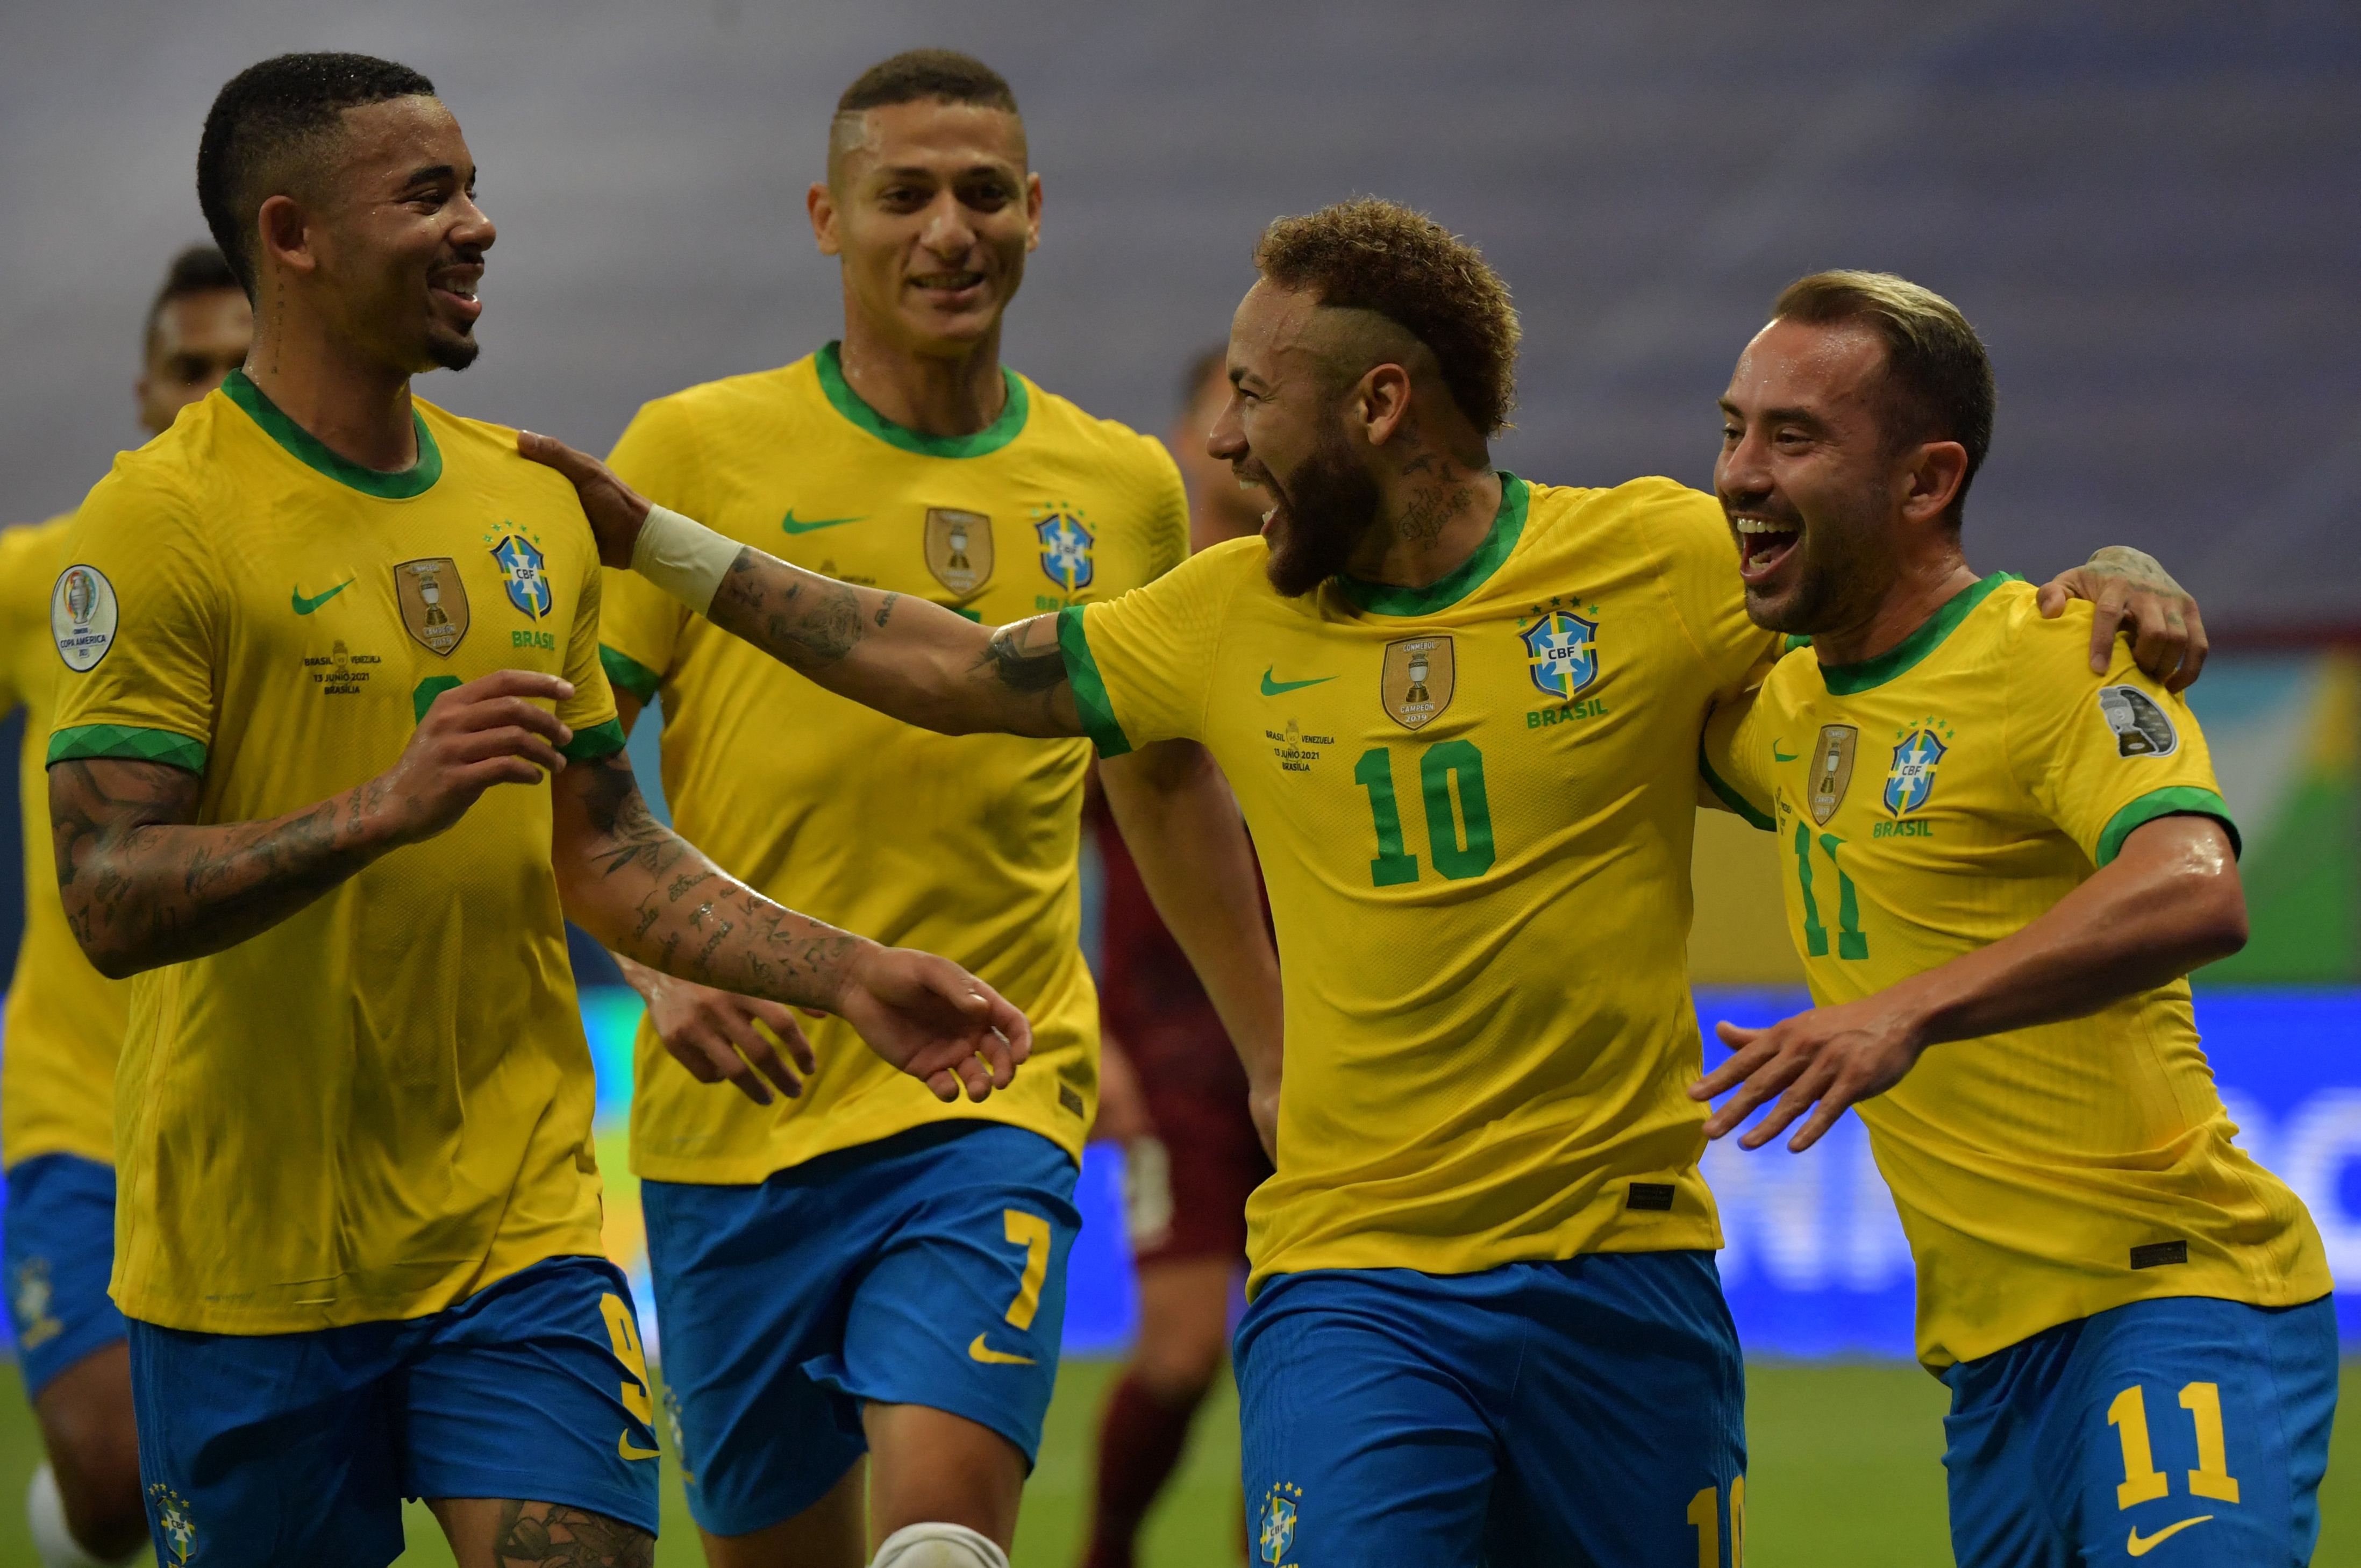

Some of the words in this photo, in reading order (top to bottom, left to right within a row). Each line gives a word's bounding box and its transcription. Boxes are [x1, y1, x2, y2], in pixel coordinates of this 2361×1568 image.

[516, 568, 535, 580] CBF
[60, 639, 74, 648] COPA
[512, 631, 555, 651] BRASIL
[1403, 642, 1436, 652] CONMEBOL
[1548, 646, 1575, 660] CBF
[304, 657, 333, 666] BRASIL
[325, 673, 349, 681] JUNIO
[1406, 714, 1426, 722] 2019
[1527, 699, 1608, 729] BRASIL
[1266, 730, 1285, 742] BRASIL
[1301, 735, 1335, 744] VENEZUELA
[1274, 748, 1280, 756] 13
[1281, 750, 1300, 759] JUNIO
[1302, 751, 1319, 759] 2021
[1902, 766, 1922, 775] CBF
[1354, 739, 1496, 887] 10
[1873, 819, 1933, 838] BRASIL
[1795, 819, 1868, 960] 11
[1004, 1209, 1051, 1331] 7
[599, 1292, 654, 1427] 9
[2108, 1381, 2240, 1510] 11
[172, 1520, 186, 1530] CBF
